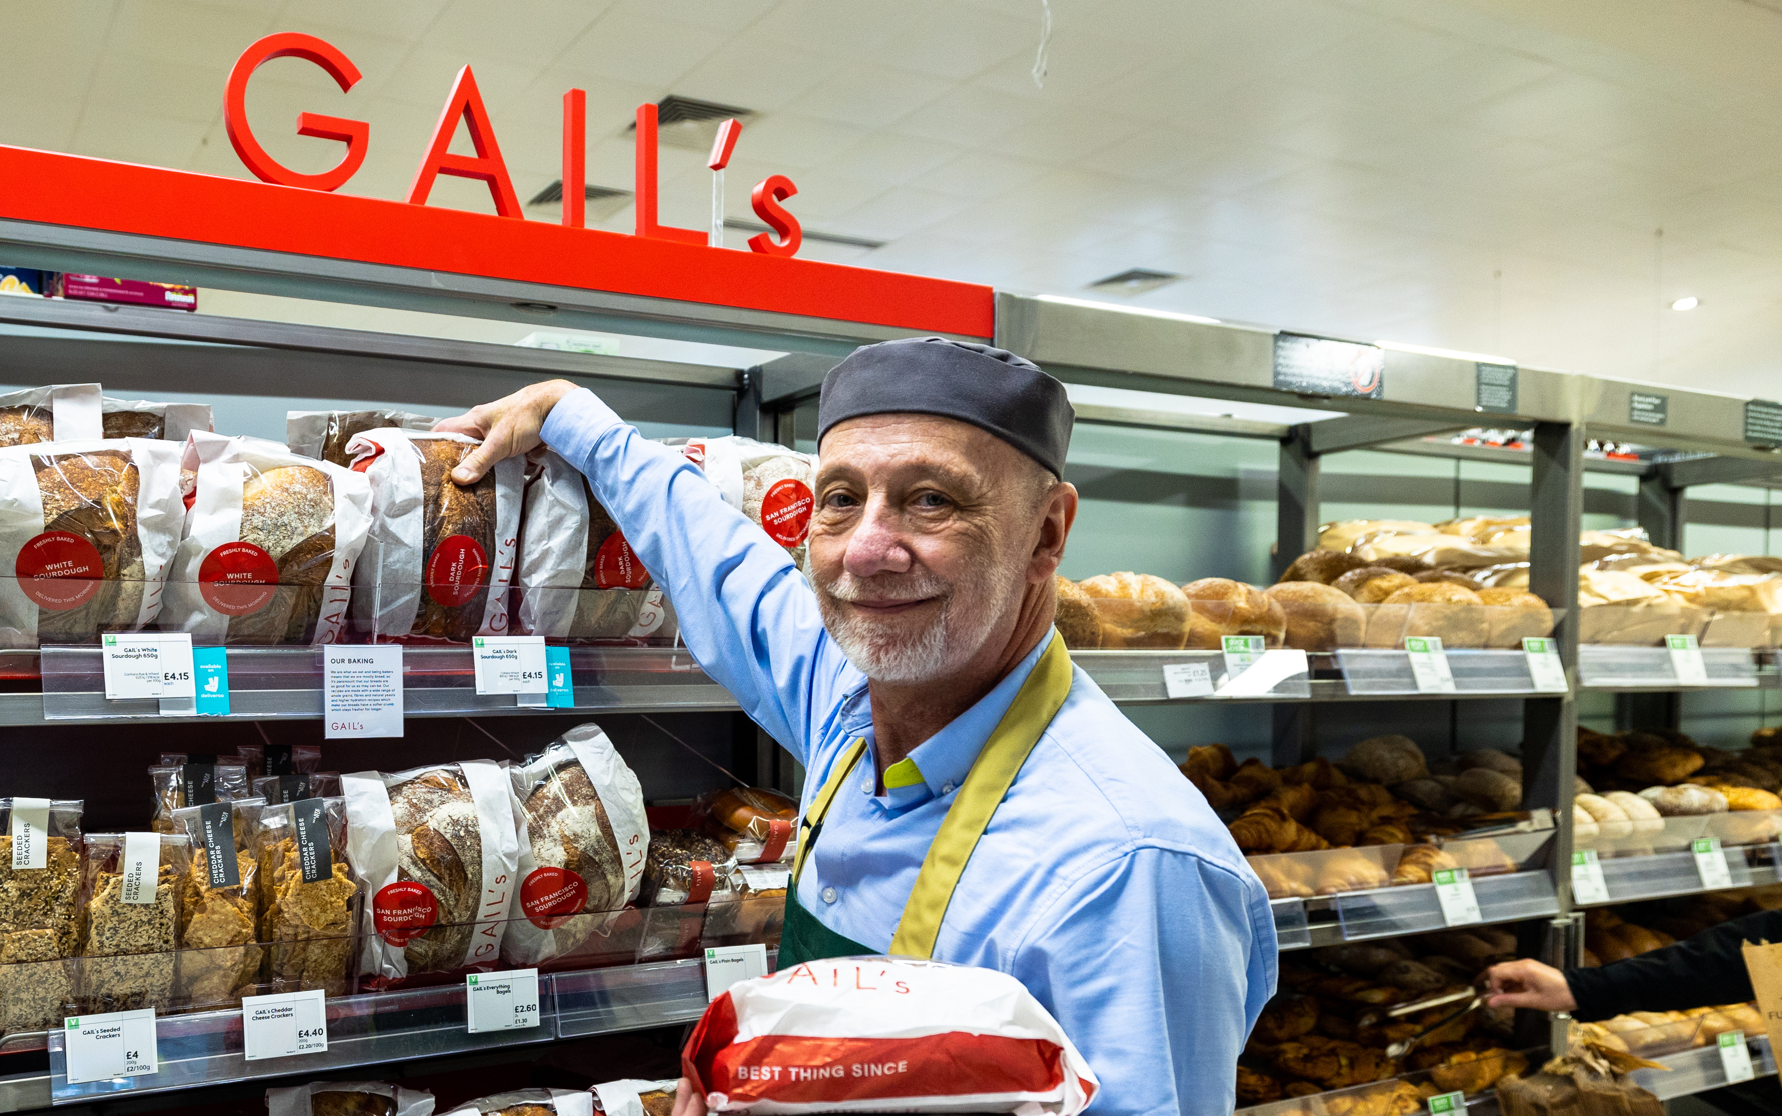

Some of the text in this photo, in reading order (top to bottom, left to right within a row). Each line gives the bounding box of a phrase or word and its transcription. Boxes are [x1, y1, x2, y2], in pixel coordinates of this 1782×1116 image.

[223, 31, 803, 259] GAIL's
[766, 511, 780, 521] SAN
[34, 537, 56, 549] FRESHLY
[220, 548, 258, 557] FRESHLY BAKED
[45, 560, 73, 570] WHITE
[449, 562, 457, 582] DARK
[453, 548, 465, 595] SOURDOUGH
[622, 541, 632, 583] SOURDOUGH
[34, 566, 89, 581] SOURDOUGH
[36, 591, 62, 603] DELIVERED
[76, 580, 94, 599] MORNING
[164, 672, 189, 681] £4.15
[331, 722, 363, 730] GAIL's
[205, 820, 219, 884] CHEDDAR CHEESE
[299, 818, 311, 880] CHEDDAR CHEESE
[308, 842, 317, 878] CRACKERS
[215, 845, 226, 883] CRACKERS
[125, 872, 134, 900] SEEDED
[133, 861, 142, 900] CRACKERS
[526, 881, 578, 908] SAN FRANCISCO
[535, 890, 576, 912] SOURDOUGH
[474, 874, 507, 958] GAIL's
[760, 962, 910, 994] AIL's
[515, 1004, 536, 1013] £2.60
[298, 1028, 324, 1038] £4.40
[126, 1051, 139, 1060] £4
[737, 1060, 908, 1082] BEST THING SINCE
